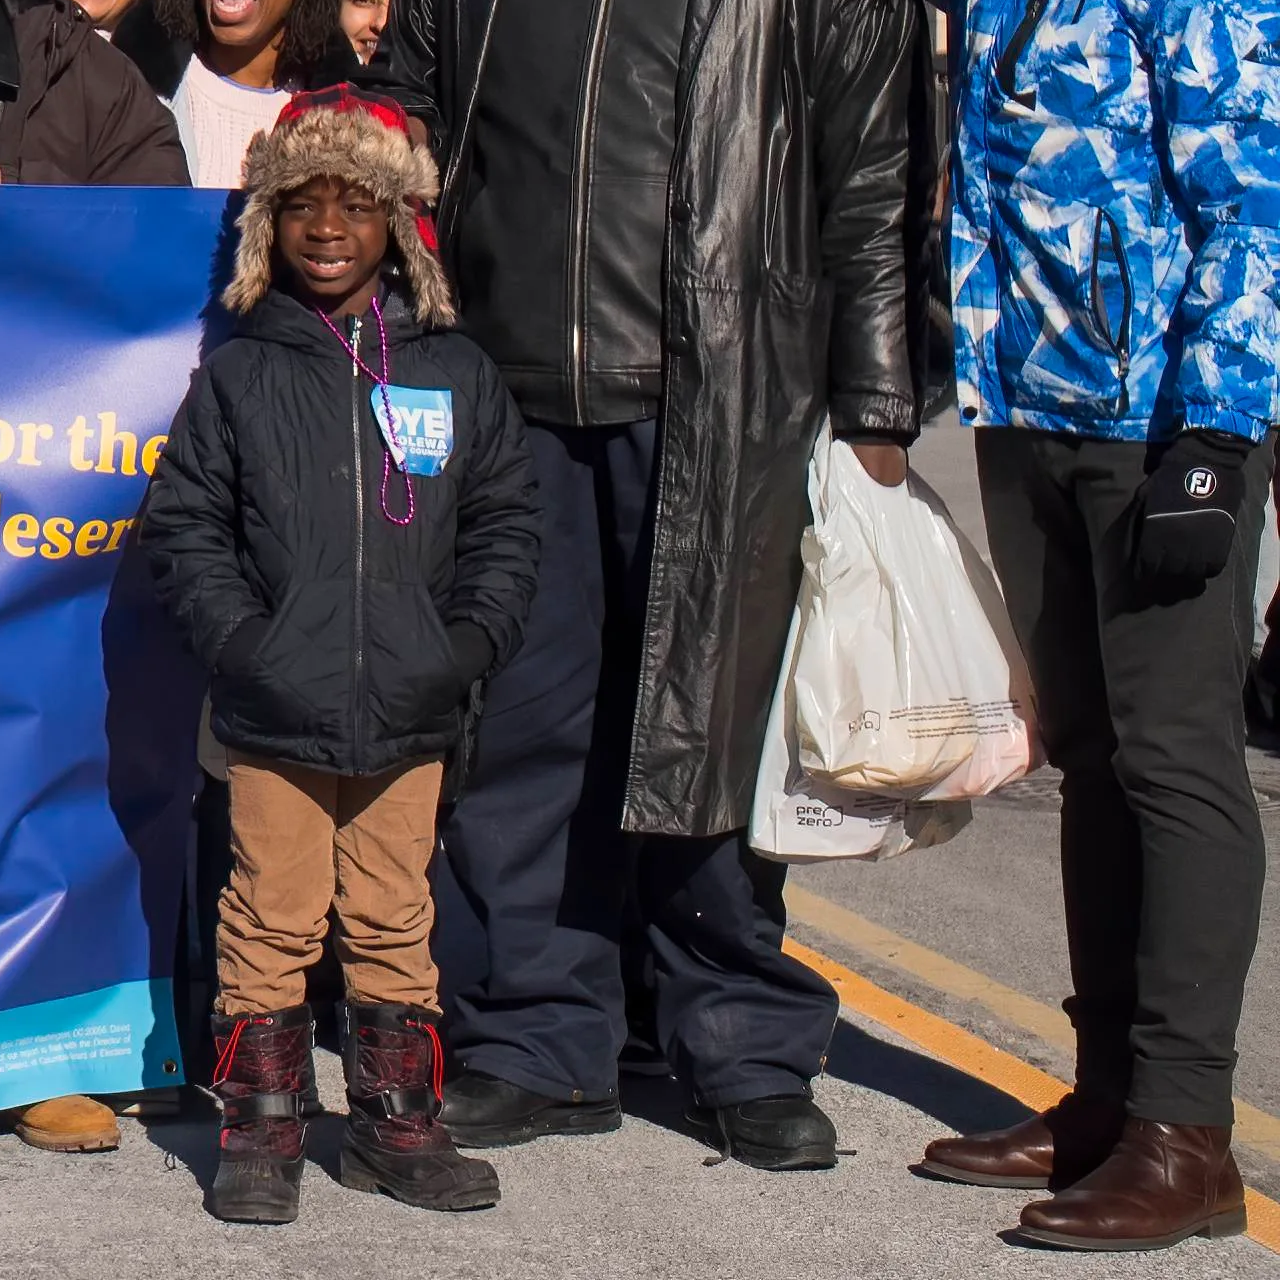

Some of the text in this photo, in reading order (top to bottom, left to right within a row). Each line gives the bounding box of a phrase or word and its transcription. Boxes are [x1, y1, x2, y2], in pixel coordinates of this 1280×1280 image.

[376, 405, 446, 439] OYE
[67, 412, 168, 476] the
[398, 435, 448, 450] OLEWA
[1190, 472, 1212, 494] FJ
[796, 805, 822, 819] pre
[797, 816, 833, 827] zero
